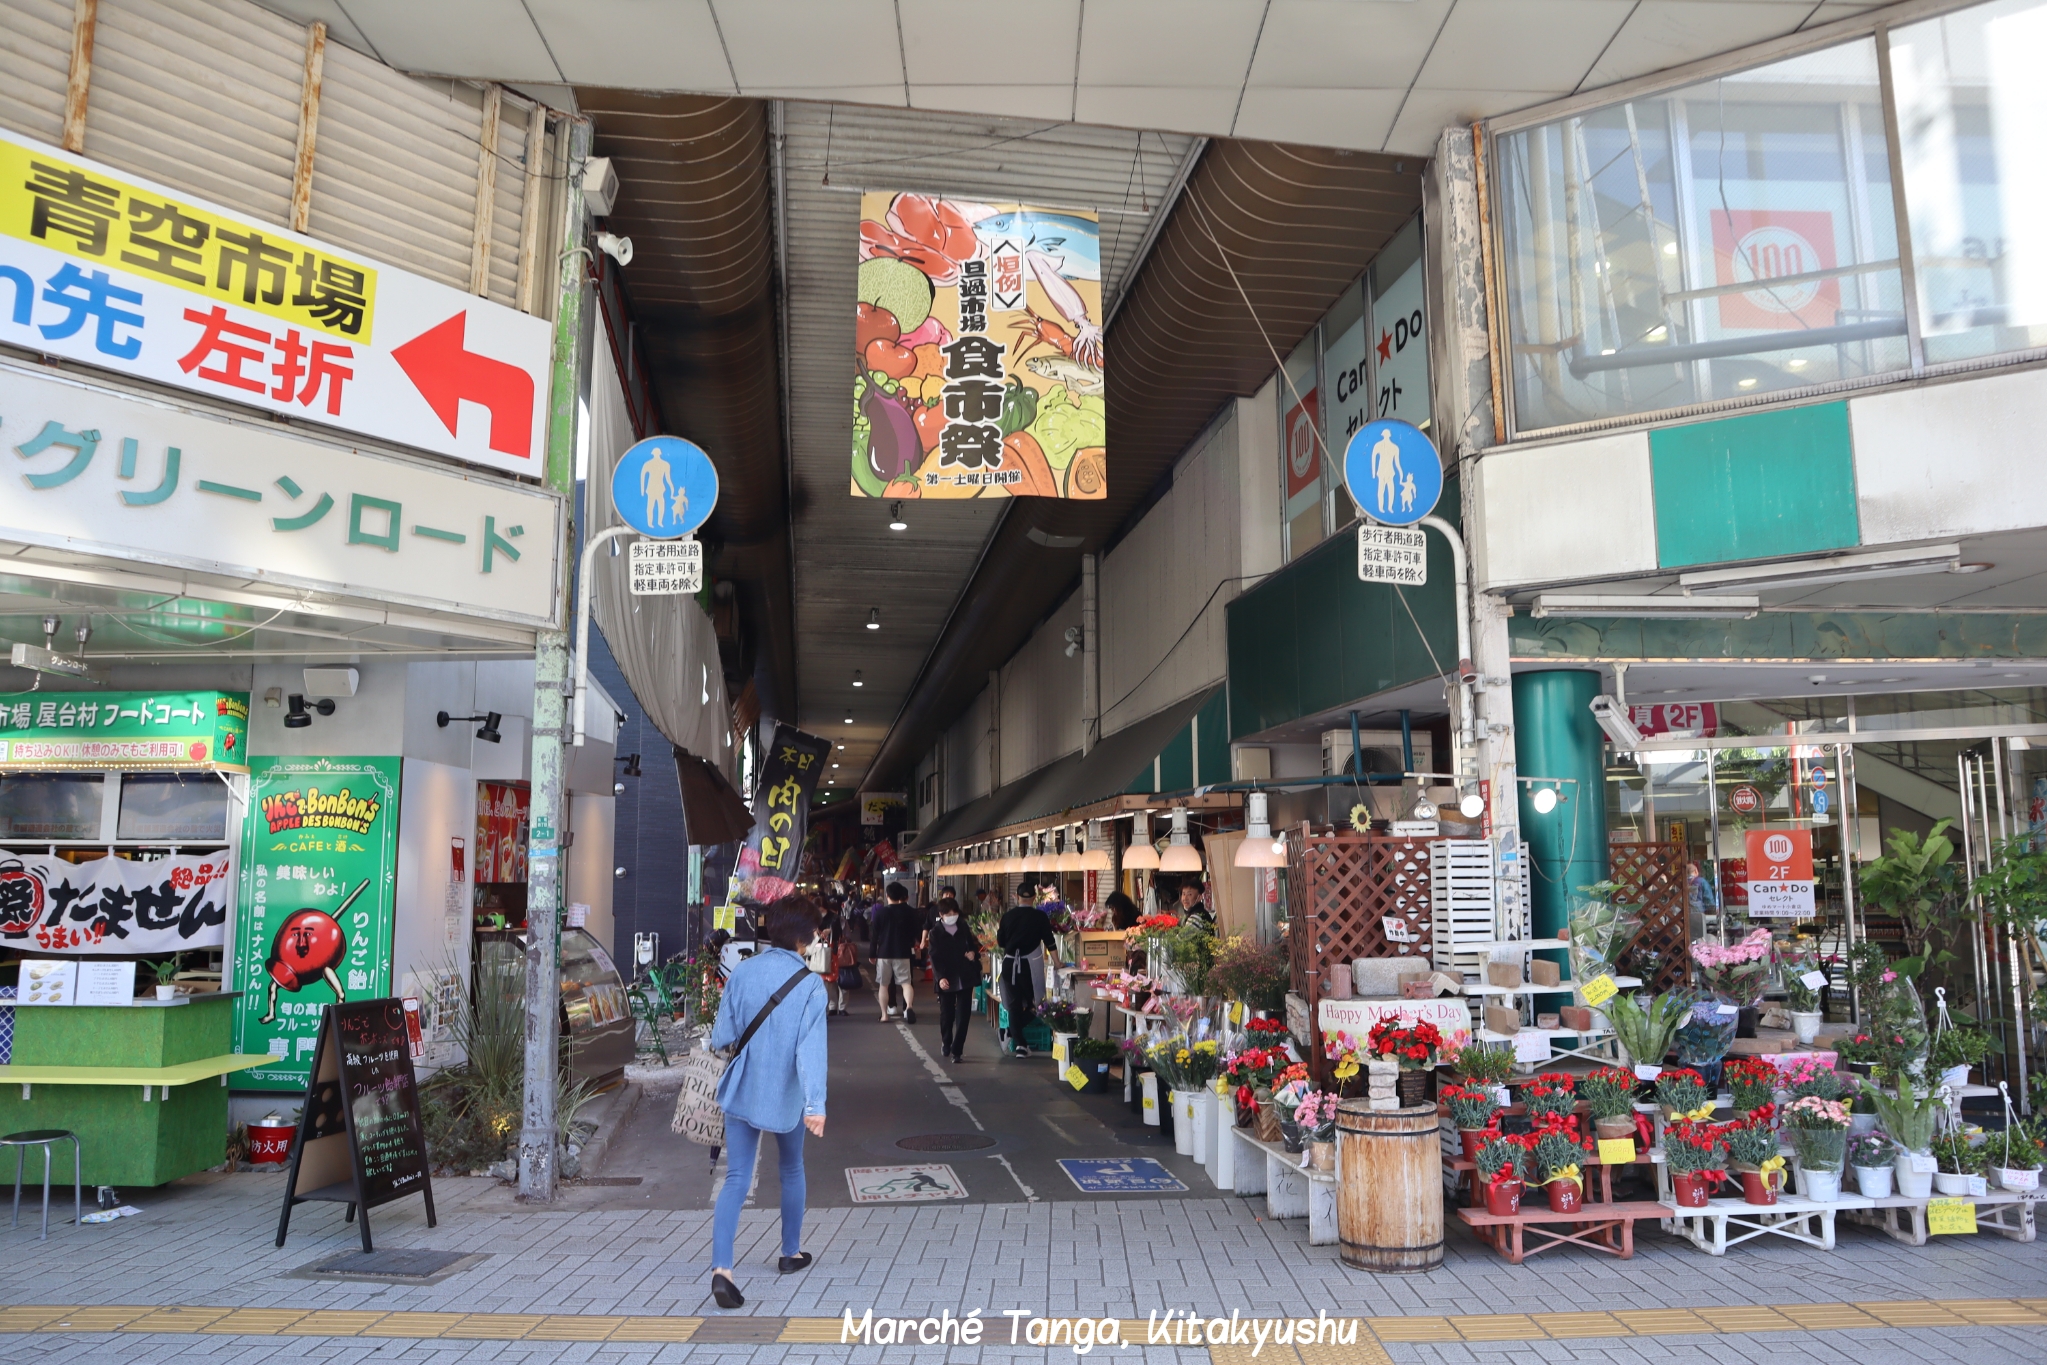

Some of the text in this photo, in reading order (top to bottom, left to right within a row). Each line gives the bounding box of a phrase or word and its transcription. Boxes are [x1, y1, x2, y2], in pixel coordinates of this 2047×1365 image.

[25, 160, 366, 335] 青空市場
[994, 255, 1022, 293] 恒例
[960, 260, 988, 332] 旦過市場
[177, 305, 354, 417] 左折
[940, 337, 1005, 468] 食市祭
[926, 472, 1022, 488] 第一土曜日開催
[14, 420, 524, 574] グリーンロード
[1362, 529, 1424, 547] 歩行者用道路
[633, 545, 699, 558] 歩行者用道路
[1362, 563, 1424, 582] 軽車両を除く
[634, 579, 699, 591] 軽車両を除く
[36, 702, 98, 728] 屋台村
[104, 698, 205, 727] フードコート
[1670, 705, 1698, 728] 2F
[779, 746, 815, 771] 本日
[270, 816, 301, 834] APPLE
[302, 815, 322, 827] DES
[760, 774, 801, 870] 肉の日
[290, 841, 323, 852] CAFE
[335, 840, 347, 852] 酒
[1769, 840, 1788, 853] 100
[276, 865, 335, 880] 美味しい
[1769, 866, 1790, 879] 2F
[314, 882, 346, 897] わよ!
[1753, 884, 1808, 893] Can Do
[348, 912, 375, 990] りんご飴!
[341, 1016, 369, 1031] りんごで
[1326, 1004, 1361, 1024] Happy
[1437, 1004, 1461, 1023] Day
[251, 1140, 288, 1154] 防火用
[1275, 1167, 1297, 1196] 花
